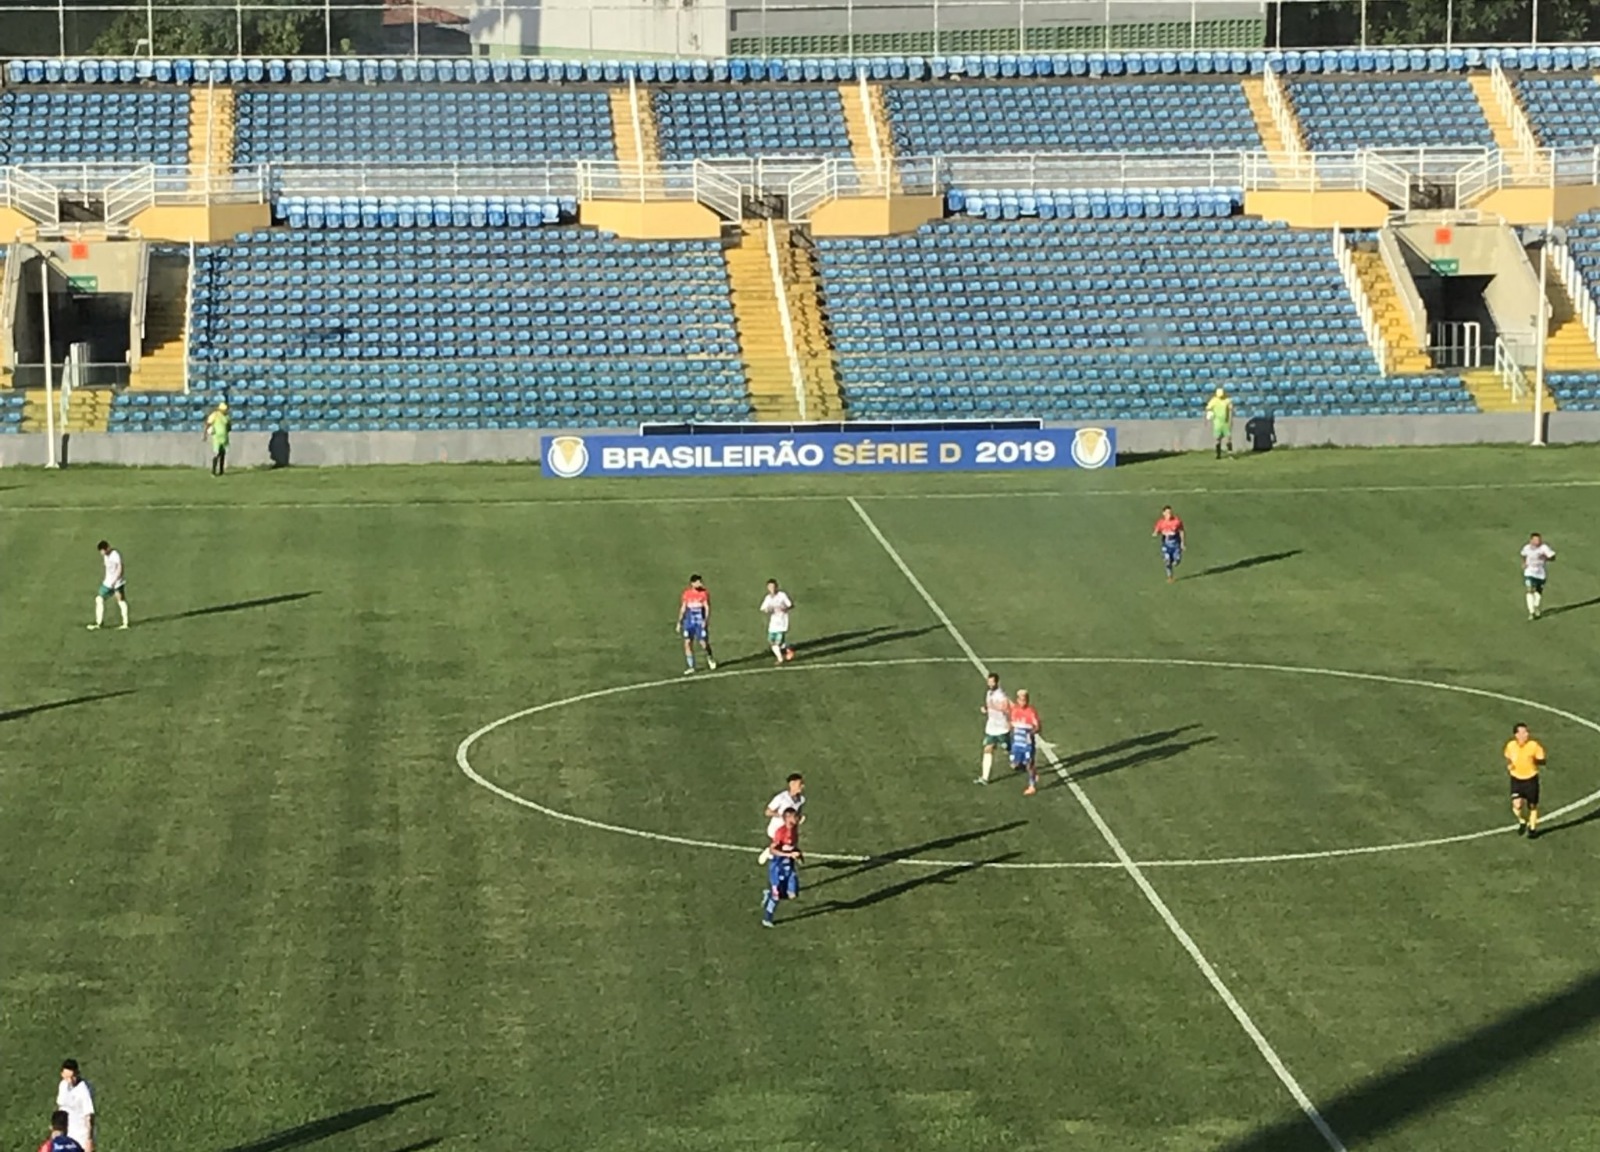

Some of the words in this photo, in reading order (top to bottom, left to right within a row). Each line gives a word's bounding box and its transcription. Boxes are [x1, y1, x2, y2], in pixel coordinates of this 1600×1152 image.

[602, 440, 824, 469] BRASILEIRÃO
[833, 439, 929, 466] SÉRIE
[939, 442, 962, 464] D
[975, 440, 1056, 463] 2019
